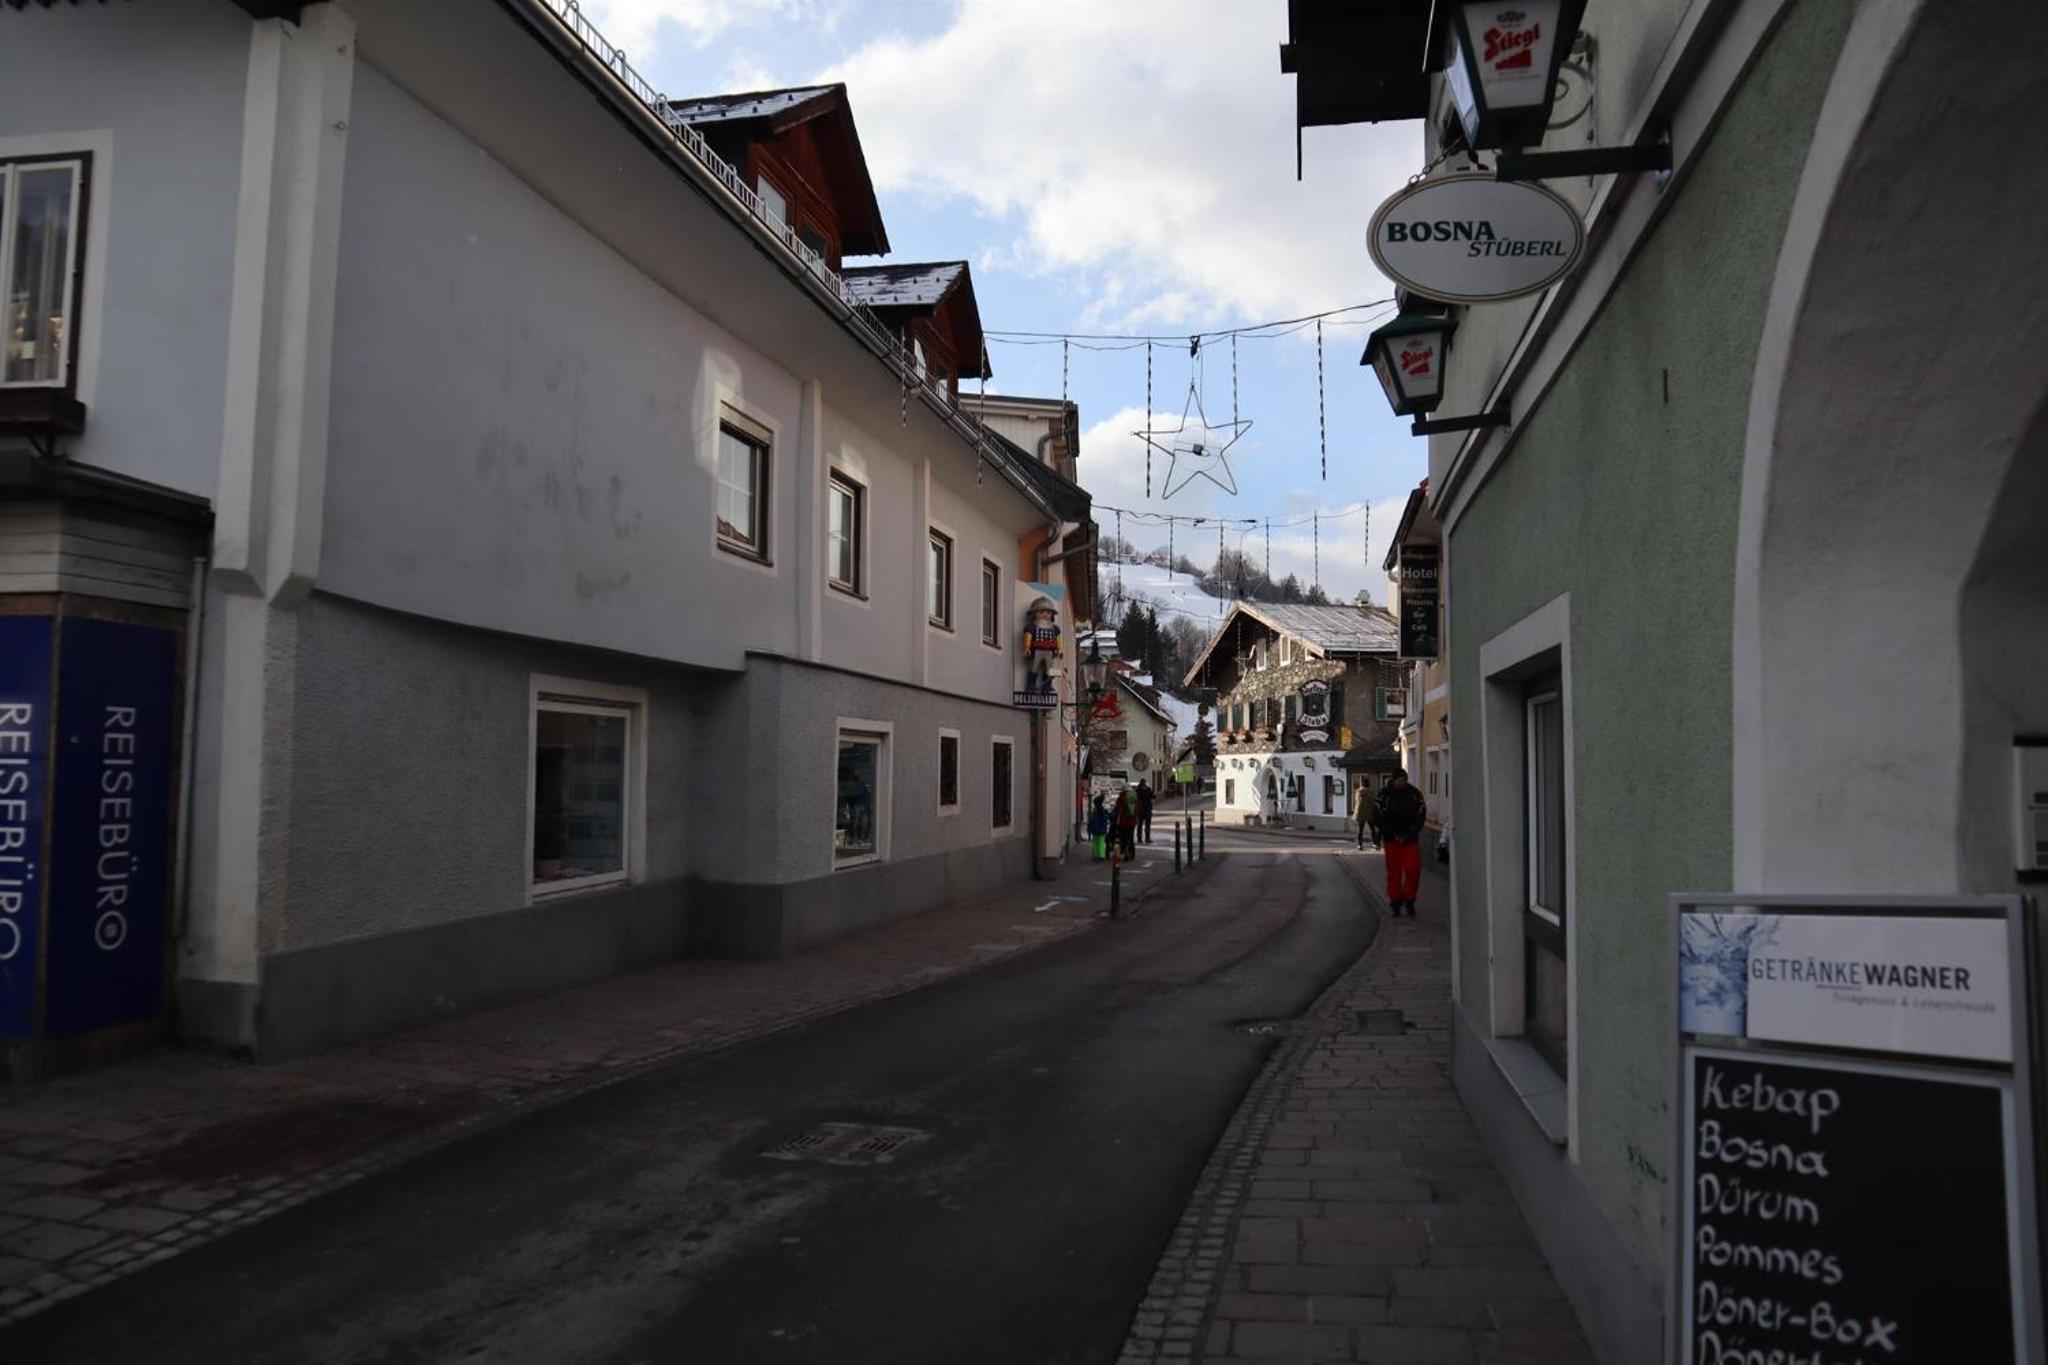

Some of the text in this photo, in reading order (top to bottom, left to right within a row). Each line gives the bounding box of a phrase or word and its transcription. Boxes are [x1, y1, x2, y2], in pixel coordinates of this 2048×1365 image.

[1484, 22, 1540, 63] Stiegl
[1387, 220, 1495, 242] BOSNA
[1467, 237, 1567, 258] STÜBERL
[94, 704, 139, 951] REISEBÜRO
[1702, 1064, 1841, 1136] Kebap
[1699, 1118, 1830, 1178] Bosna
[1697, 1171, 1819, 1227] Dürum
[1696, 1223, 1845, 1287] Pommes
[1697, 1279, 1899, 1354] Döner-Box
